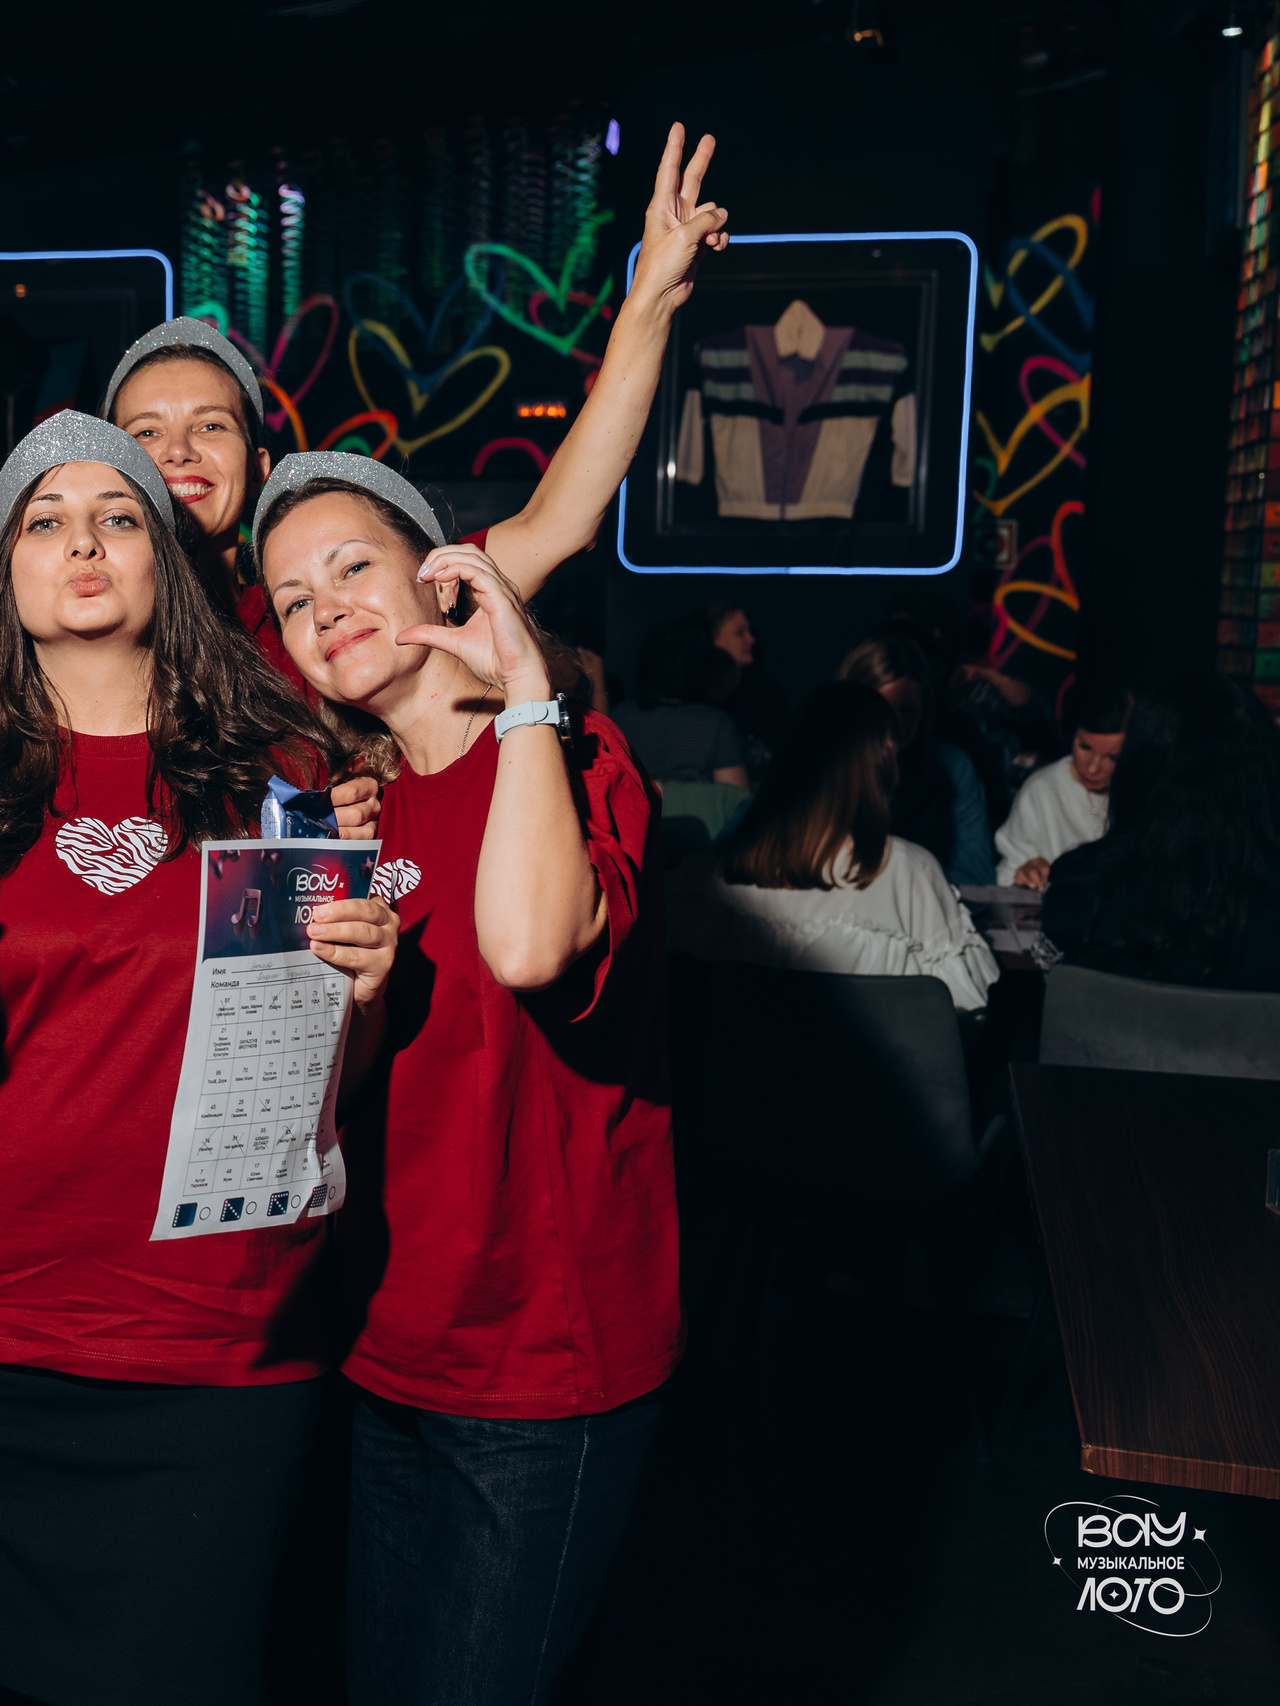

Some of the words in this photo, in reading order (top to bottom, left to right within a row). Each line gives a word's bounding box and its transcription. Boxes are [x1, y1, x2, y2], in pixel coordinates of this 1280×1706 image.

[295, 873, 339, 892] ВАУ
[294, 895, 335, 903] МУЗЫКАЛЬНОЕ
[210, 980, 240, 988] Команда
